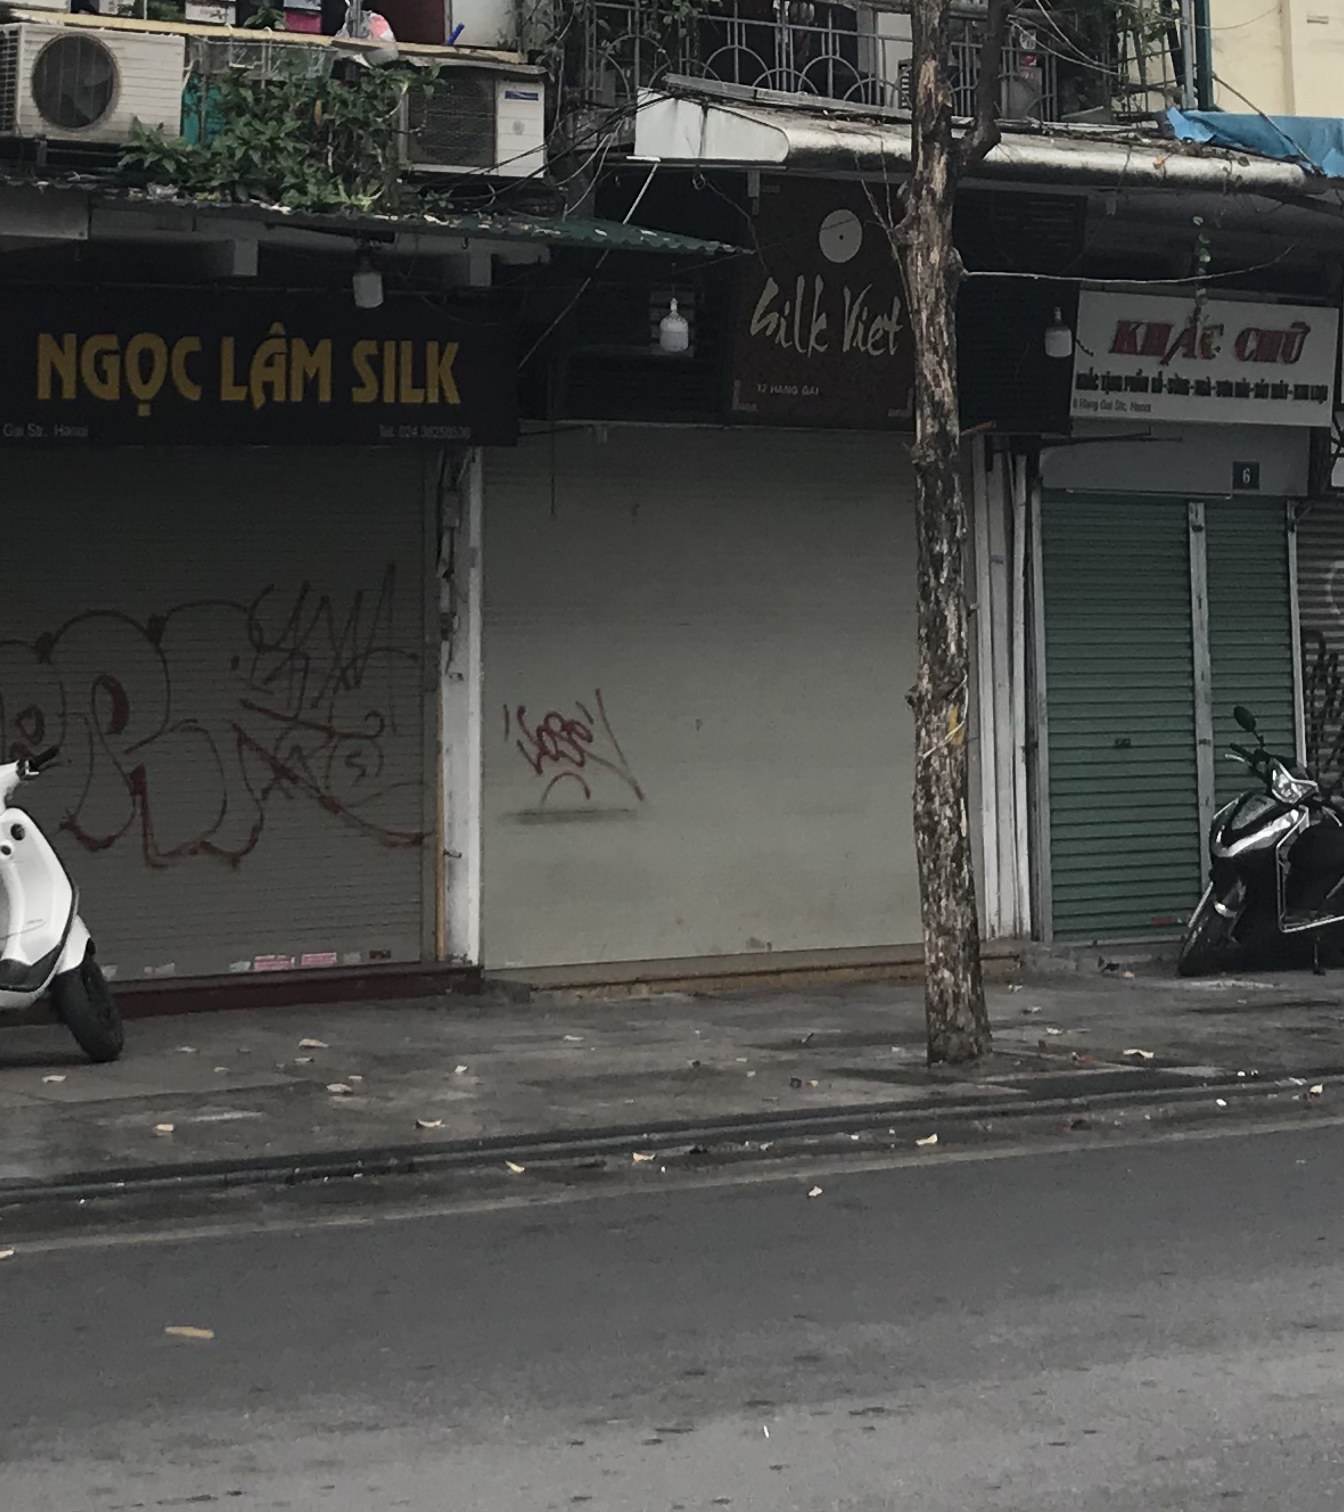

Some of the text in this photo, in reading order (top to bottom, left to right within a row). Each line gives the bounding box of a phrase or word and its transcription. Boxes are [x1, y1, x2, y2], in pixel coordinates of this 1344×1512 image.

[750, 274, 829, 360] Silk
[36, 321, 462, 417] NGỌC LÂM SILK
[1242, 467, 1251, 484] 6
